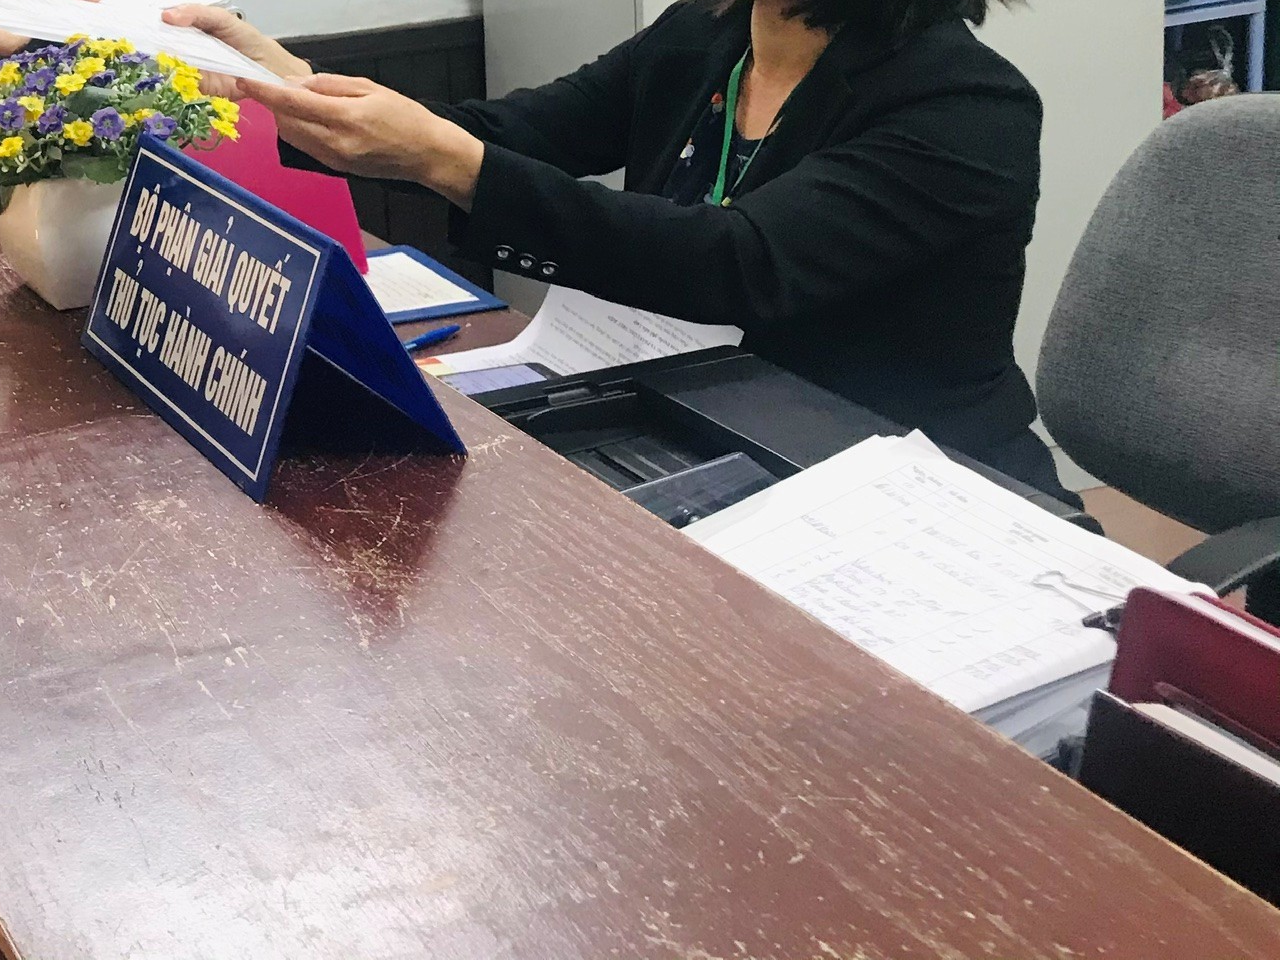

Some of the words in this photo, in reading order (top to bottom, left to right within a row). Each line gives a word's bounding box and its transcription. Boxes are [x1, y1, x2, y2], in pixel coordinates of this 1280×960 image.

[129, 184, 160, 254] BỘ
[150, 200, 202, 277] PHẬN
[193, 215, 235, 298] GIẢI
[227, 252, 293, 336] QUYẾT
[104, 258, 144, 330] THỦ
[130, 286, 168, 358] TỤC
[158, 305, 213, 392] HÀNH
[204, 347, 268, 437] CHÍNH
